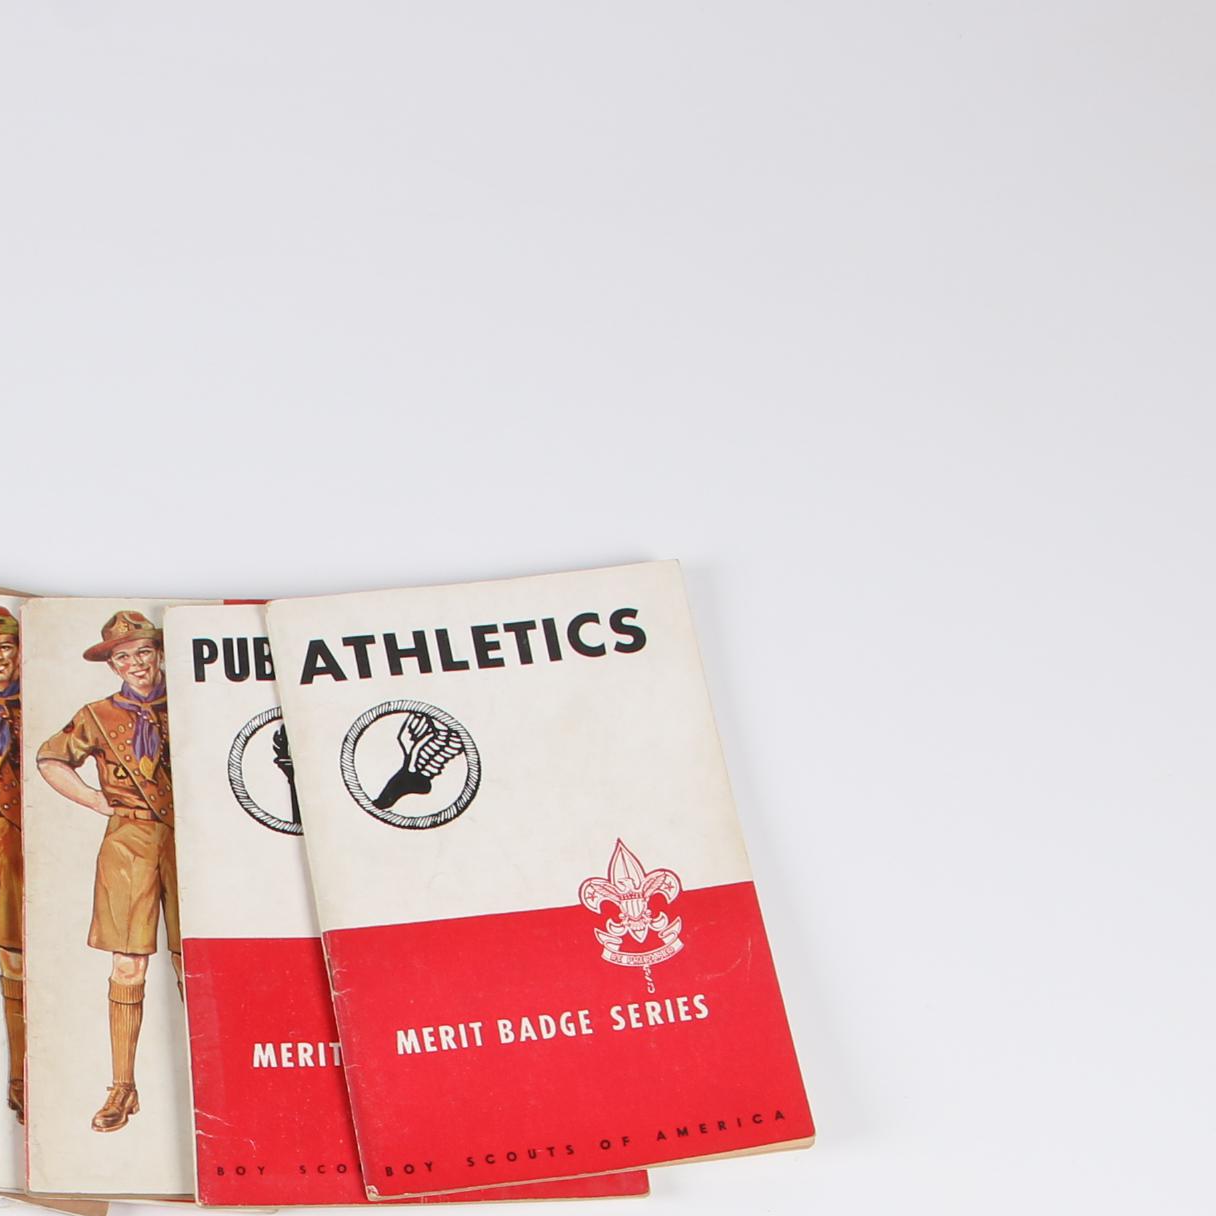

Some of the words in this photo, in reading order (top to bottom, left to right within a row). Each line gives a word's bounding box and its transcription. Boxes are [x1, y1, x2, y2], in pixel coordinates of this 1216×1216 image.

[192, 637, 275, 682] PUB
[299, 607, 647, 685] ATHLETICS
[396, 1022, 484, 1055] MERIT
[499, 1009, 593, 1045] BADGE
[610, 994, 710, 1031] SERIES
[252, 1042, 342, 1068] MERIT
[385, 1160, 434, 1177] BOY
[466, 1144, 575, 1167] SCOUTS
[600, 1135, 630, 1150] OF
[656, 1110, 786, 1142] AMERICA
[216, 1165, 267, 1177] BOY
